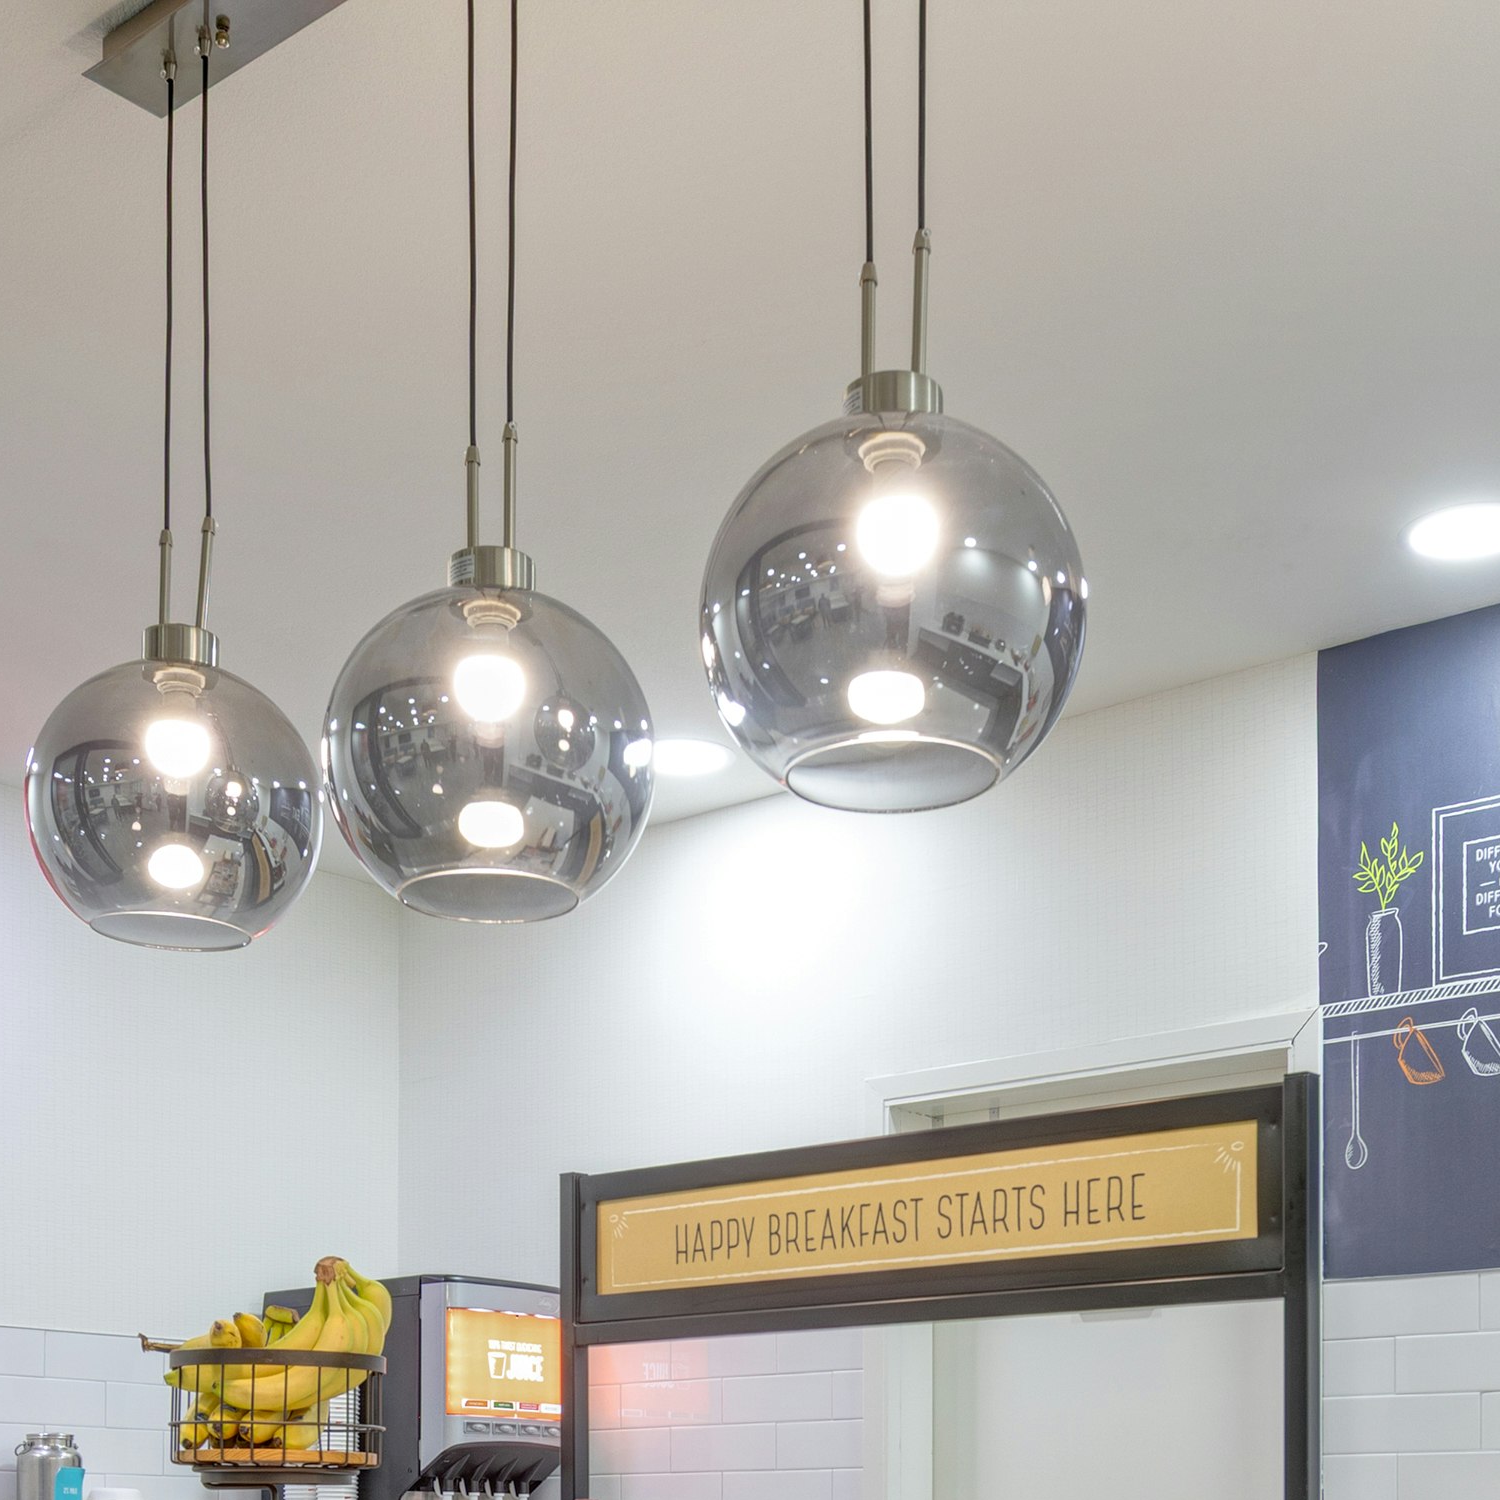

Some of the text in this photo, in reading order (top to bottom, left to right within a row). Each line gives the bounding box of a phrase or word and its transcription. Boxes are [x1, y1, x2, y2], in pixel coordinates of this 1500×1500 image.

[675, 1173, 1146, 1265] HAPPY BREAKFAST STARTS HERE
[506, 1354, 544, 1382] JUICE
